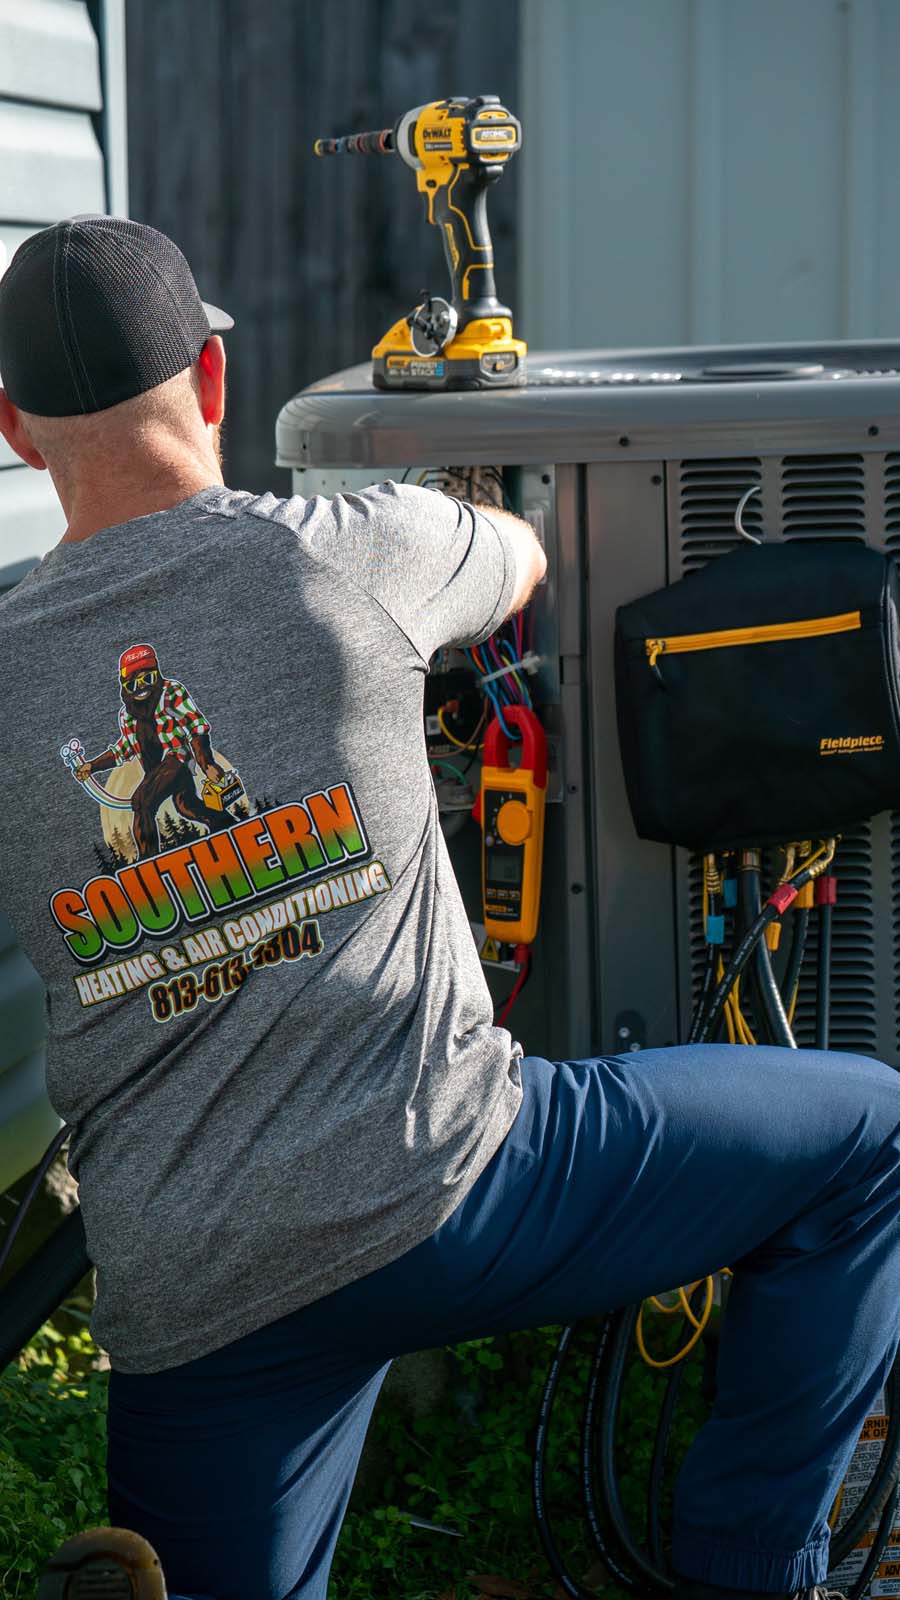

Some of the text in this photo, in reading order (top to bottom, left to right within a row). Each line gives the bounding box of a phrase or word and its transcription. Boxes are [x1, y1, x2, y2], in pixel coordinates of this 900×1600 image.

[820, 736, 883, 749] Fieldpiece
[51, 783, 368, 961] SOUTHERN
[74, 861, 391, 1007] HEATING & AIR CONDITIONING
